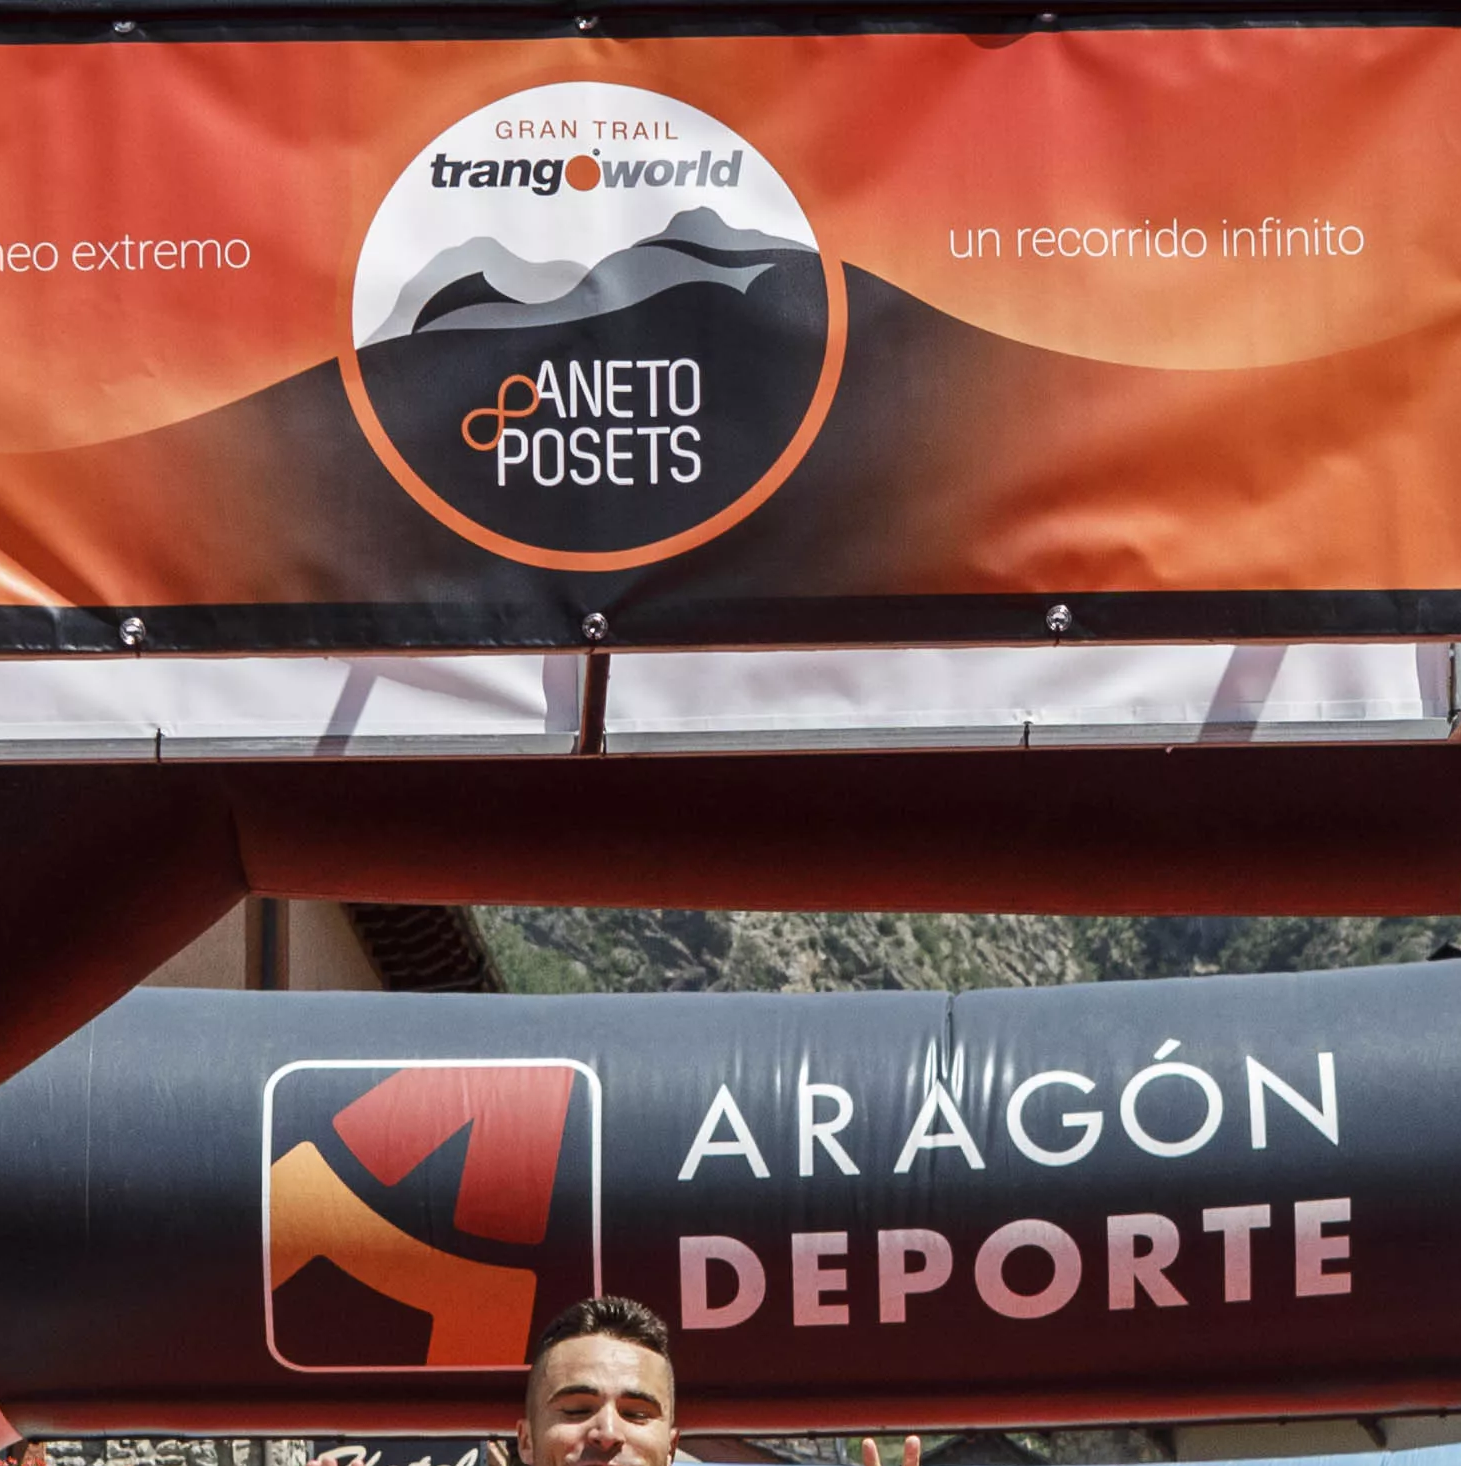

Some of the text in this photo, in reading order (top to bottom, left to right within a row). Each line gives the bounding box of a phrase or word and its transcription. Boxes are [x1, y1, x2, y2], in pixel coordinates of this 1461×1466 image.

[495, 120, 679, 140] GRAN TRAIL
[72, 235, 251, 271] extremo
[949, 217, 1366, 259] un recorrido infinito
[537, 357, 701, 418] ANETO
[496, 424, 701, 486] POSETS
[677, 1038, 1338, 1181] ARAGÓN
[678, 1197, 1352, 1330] DEPORTE
